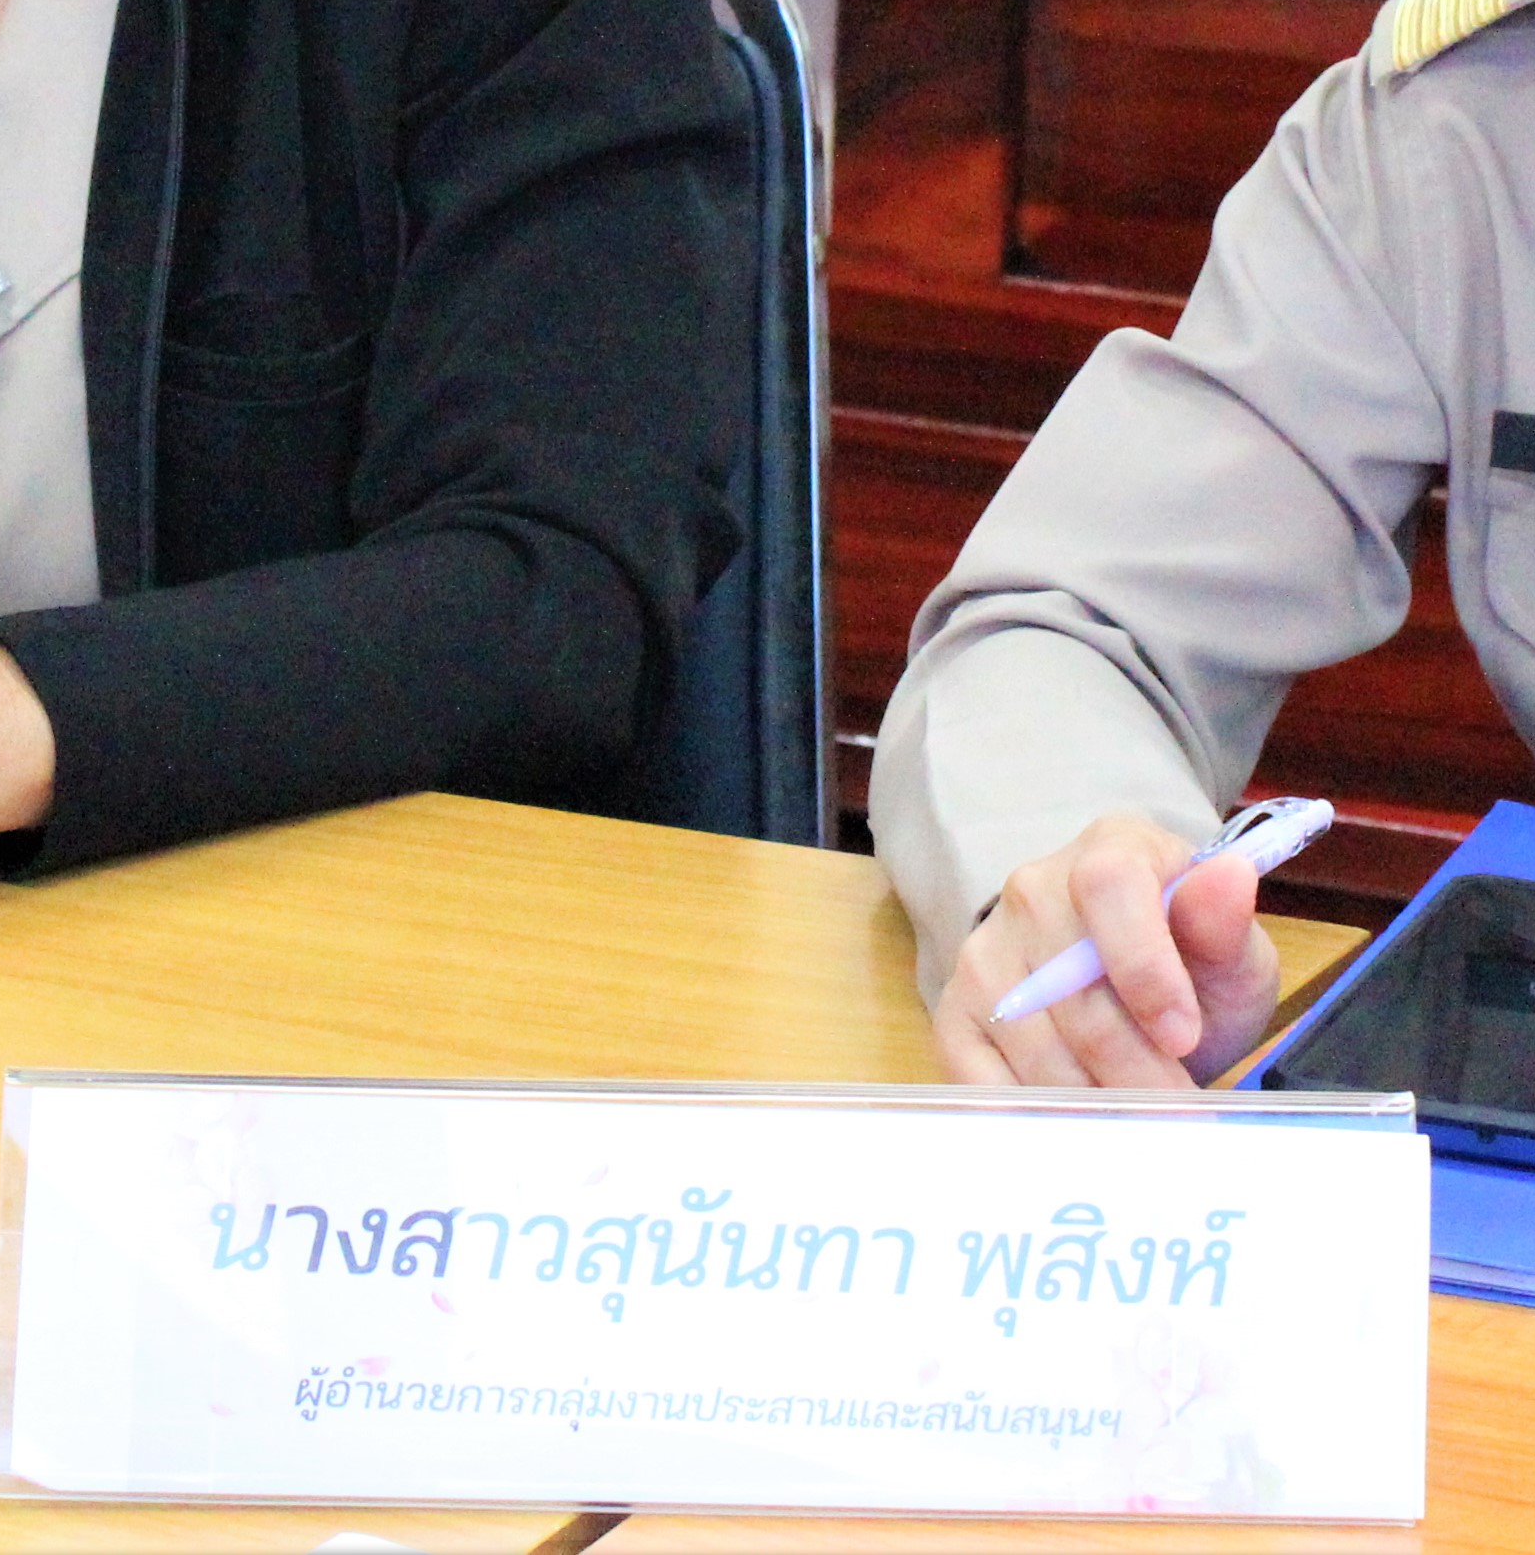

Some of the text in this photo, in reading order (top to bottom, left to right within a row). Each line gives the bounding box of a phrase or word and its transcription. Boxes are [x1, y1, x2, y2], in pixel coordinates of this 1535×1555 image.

[210, 1187, 1247, 1338] นางสาวสุนันทา พุสิงห์
[293, 1365, 1123, 1451] ผู้อำนวยการกลุ่มงานประสานและสนับสนุนฯ
